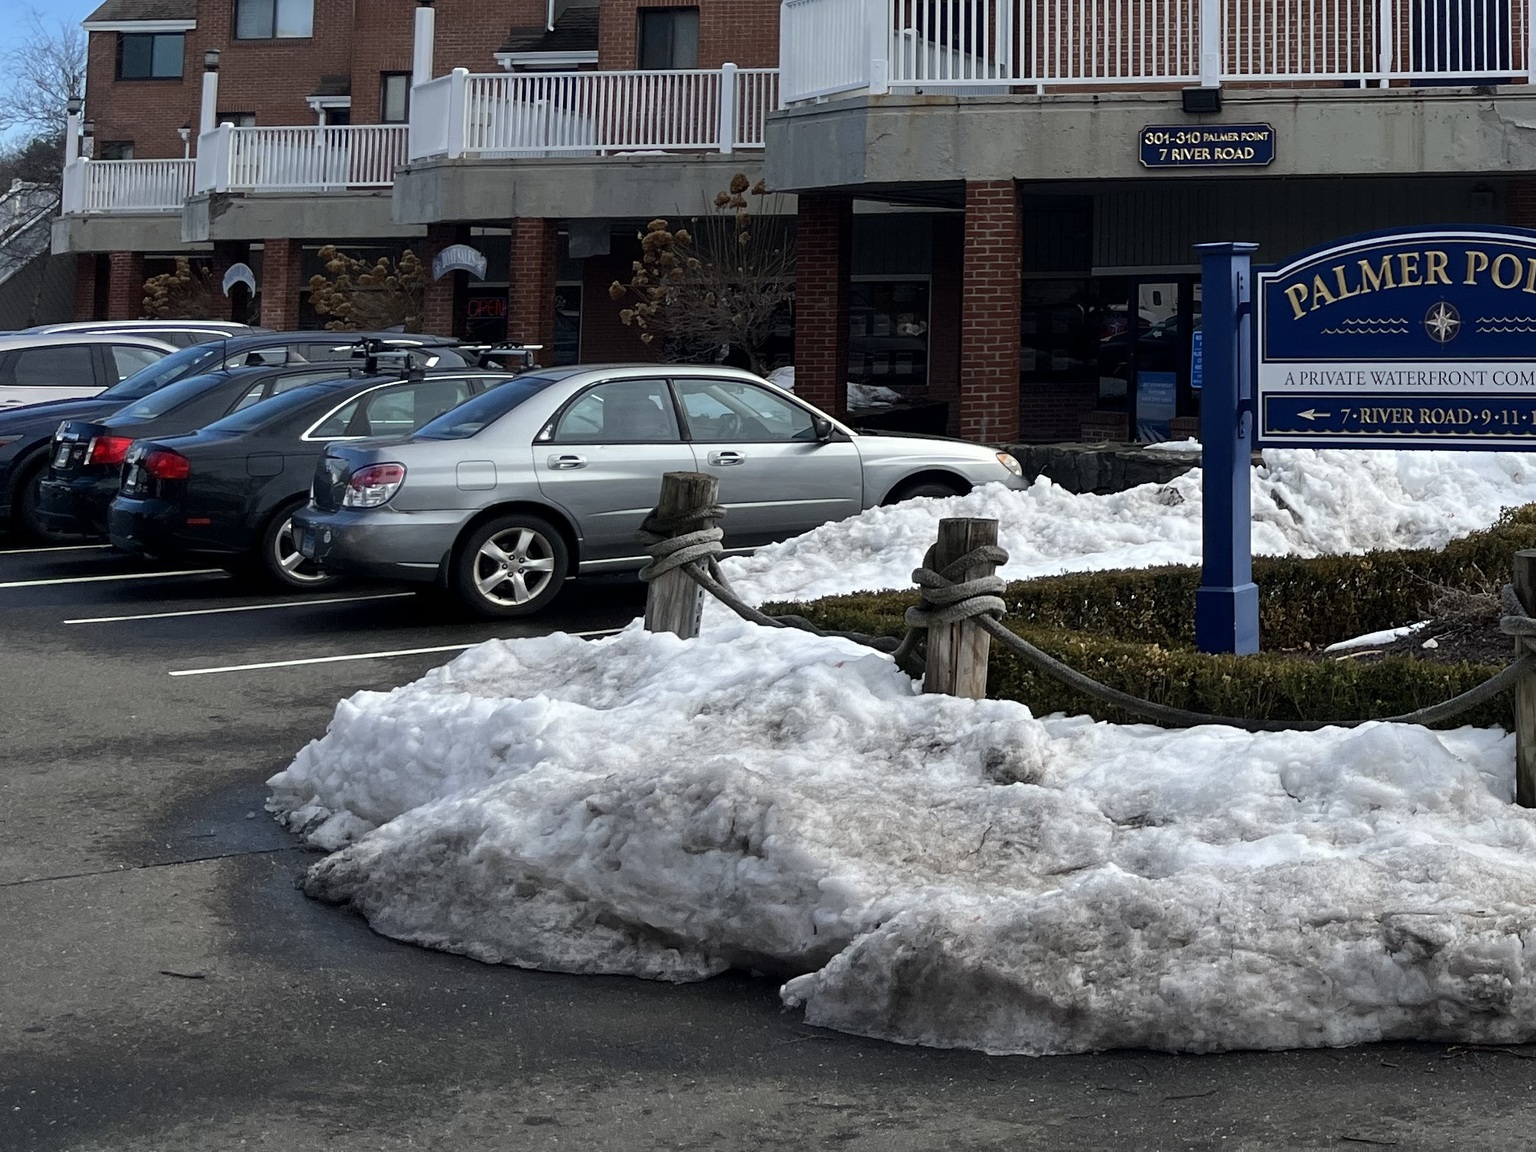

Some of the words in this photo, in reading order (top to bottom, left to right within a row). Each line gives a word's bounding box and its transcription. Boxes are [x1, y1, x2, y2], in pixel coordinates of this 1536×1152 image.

[1144, 131, 1200, 145] 301-310
[1203, 132, 1239, 142] PALMER
[1241, 131, 1269, 142] POINT
[1159, 148, 1168, 161] 7
[1171, 147, 1211, 161] RIVER
[1214, 147, 1255, 160] ROAD
[1284, 250, 1453, 320] PALMER
[467, 299, 505, 317] OPEN
[1284, 371, 1296, 386] A
[1299, 371, 1366, 386] PRIVATE
[1370, 370, 1488, 386] WATERFRONT
